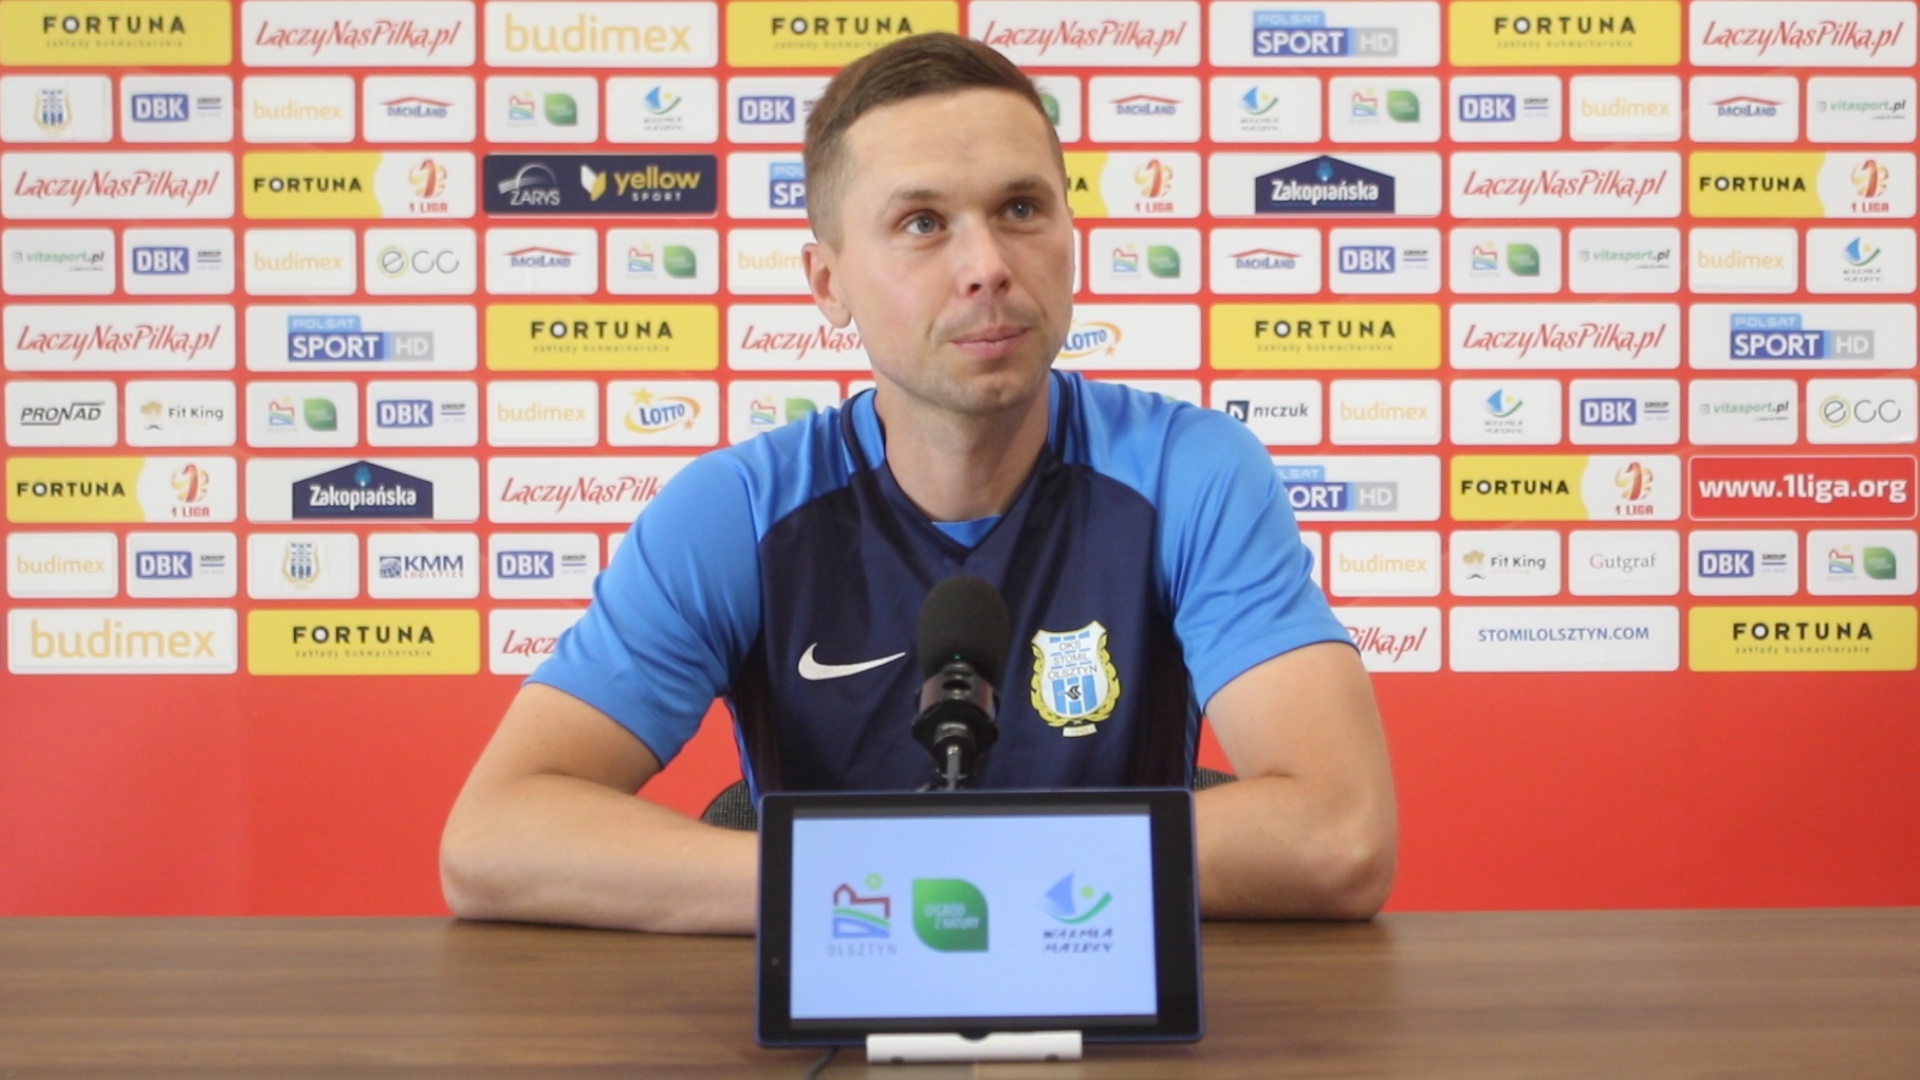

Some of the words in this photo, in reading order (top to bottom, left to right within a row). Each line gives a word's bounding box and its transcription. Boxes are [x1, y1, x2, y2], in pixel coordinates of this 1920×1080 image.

[42, 15, 185, 33] FORTUNA
[771, 16, 912, 34] FORTUNA
[1257, 13, 1320, 24] POLSAT
[1494, 16, 1636, 34] FORTUNA
[504, 14, 691, 52] budimex
[1257, 31, 1343, 53] SPORT
[1360, 32, 1392, 51] HD
[137, 96, 186, 118] DBK
[253, 100, 341, 118] budimex
[743, 99, 790, 120] DBK
[1464, 96, 1510, 119] DBK
[1582, 98, 1669, 116] budimex
[613, 165, 699, 193] yellow
[775, 166, 806, 176] POL
[253, 177, 361, 192] FORTUNA
[1272, 181, 1377, 203] Zakopiańska
[1700, 176, 1806, 191] FORTUNA
[510, 191, 559, 205] ZARYS
[632, 192, 681, 200] SPORT
[420, 202, 448, 212] LIGA
[1145, 202, 1174, 212] LIGA
[1861, 202, 1889, 212] LIGA
[137, 249, 186, 271] DBK
[254, 253, 342, 270] budimex
[739, 251, 802, 269] budim
[1343, 248, 1392, 270] DBK
[1698, 250, 1783, 268] budimex
[292, 318, 356, 329] POLSAT
[530, 320, 673, 338] FORTUNA
[1255, 320, 1395, 338] FORTUNA
[1735, 316, 1796, 327] POLSAT
[292, 335, 378, 357] SPORT
[395, 336, 428, 356] HD
[740, 325, 861, 359] LaczyNas
[1735, 333, 1819, 356] SPORT
[1835, 335, 1868, 354] HD
[21, 403, 104, 425] PRONAD
[168, 406, 186, 420] Fit
[191, 405, 223, 422] King
[382, 402, 429, 424] DBK
[498, 405, 585, 422] budimex
[638, 403, 685, 425] LOTTO
[1340, 401, 1428, 420] budimex
[1585, 401, 1633, 423] DBK
[1280, 469, 1320, 479] LSAT
[17, 482, 125, 496] FORTUNA
[501, 476, 661, 511] LaczyNasPilk
[1290, 484, 1343, 508] ORT
[1359, 486, 1392, 505] HD
[1461, 480, 1568, 494] FORTUNA
[1699, 474, 1906, 503] www.1liga.org
[309, 485, 416, 509] Zakopiańska
[182, 507, 210, 517] LIGA
[1626, 504, 1654, 514] LIGA
[17, 555, 104, 573] budimex
[140, 553, 189, 575] DBK
[404, 555, 464, 570] KMM
[502, 553, 550, 575] DBK
[1339, 554, 1427, 572] budimex
[1491, 554, 1510, 568] Fit
[1512, 554, 1545, 570] King
[1589, 553, 1656, 572] Gutgraf
[1703, 552, 1750, 574] DBK
[30, 620, 215, 658] budimex
[292, 625, 434, 643] FORTUNA
[1477, 627, 1649, 642] STOMILOLSZTYN.COM
[1732, 622, 1873, 640] FORTUNA
[1060, 640, 1081, 650] OKS
[1053, 654, 1088, 664] STOMIL
[1048, 665, 1097, 678] OLSZTYN
[827, 944, 897, 956] OLSZTYN
